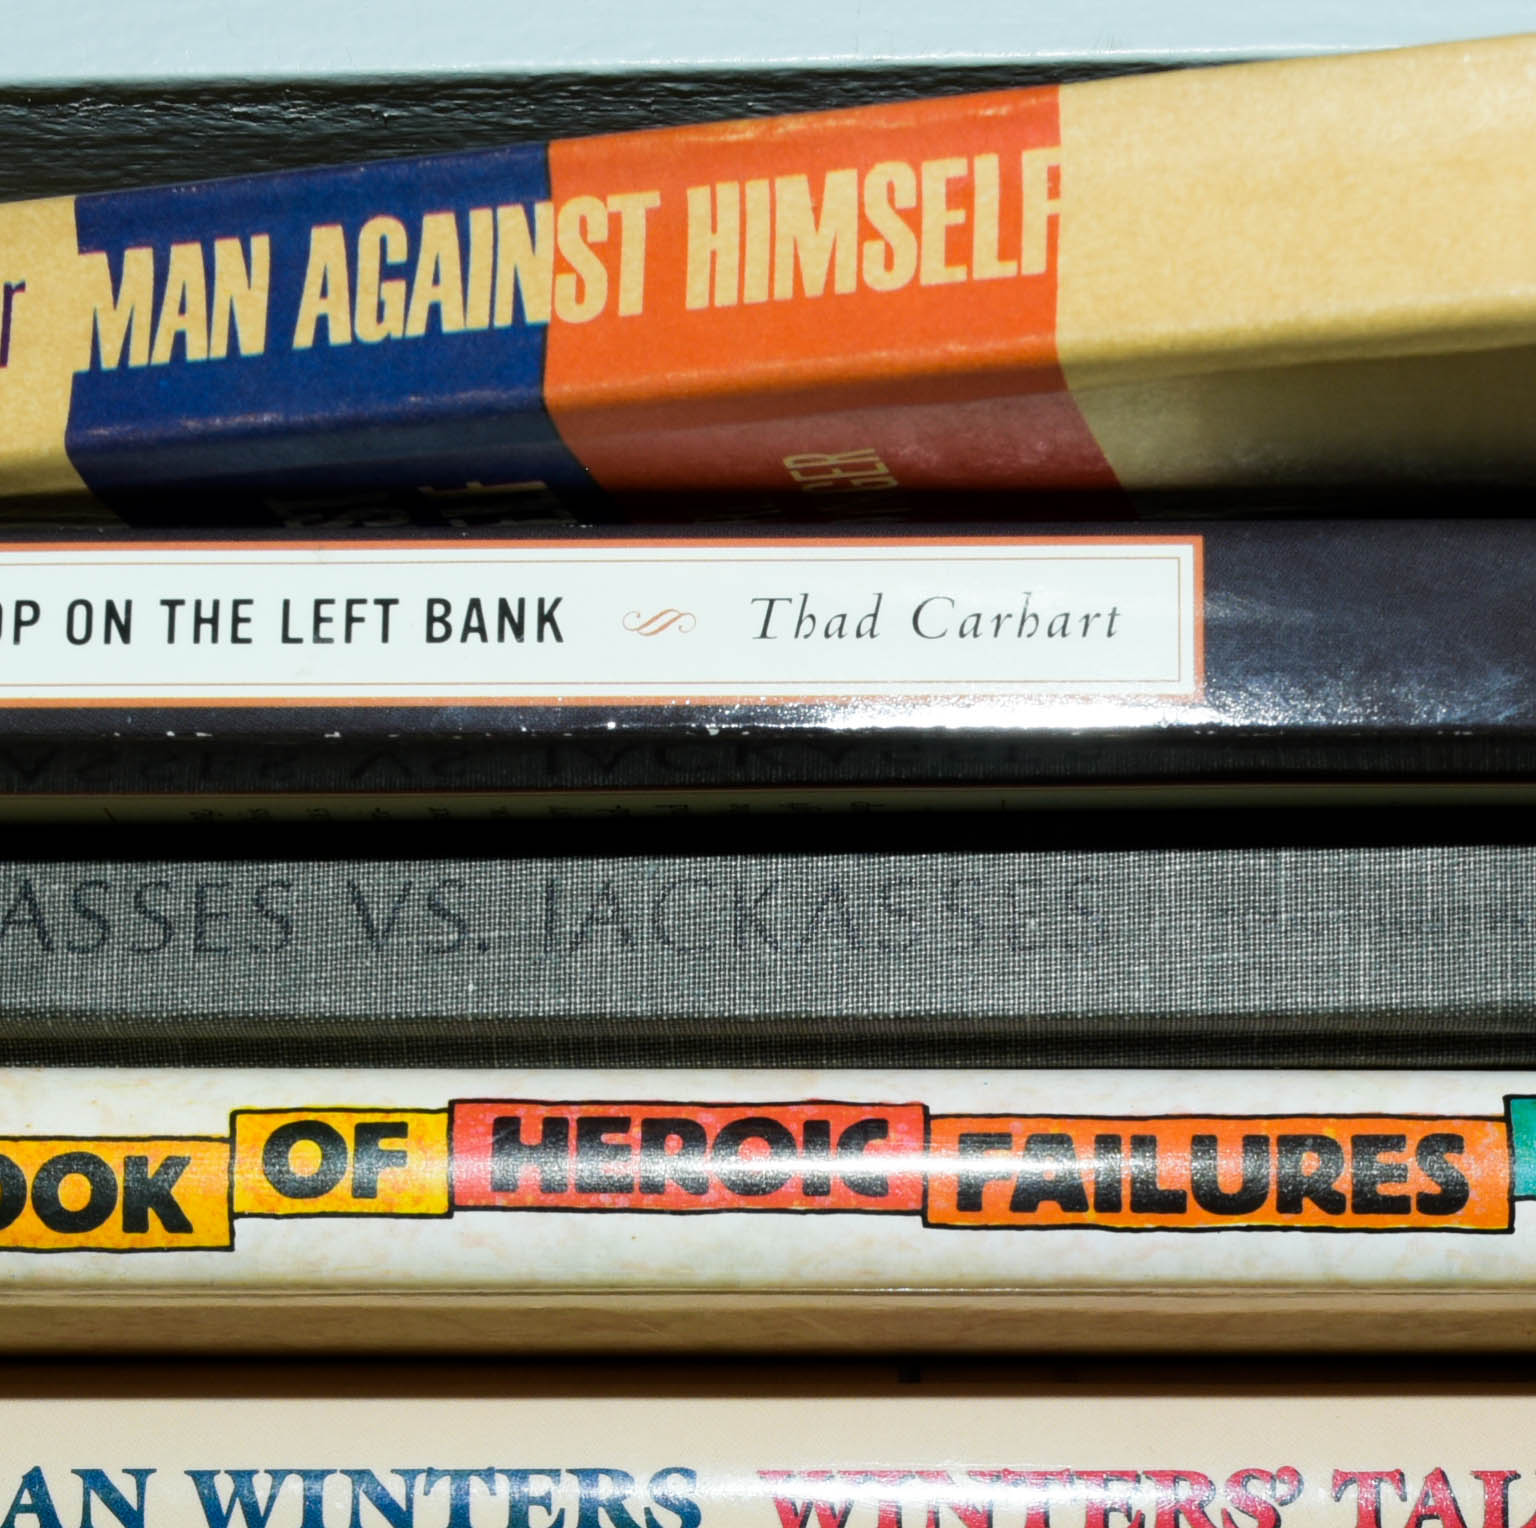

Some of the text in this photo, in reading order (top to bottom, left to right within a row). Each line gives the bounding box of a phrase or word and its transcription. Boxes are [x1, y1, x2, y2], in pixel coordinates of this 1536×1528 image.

[72, 145, 1063, 373] MAN AGAINST HIMSELF
[66, 598, 133, 645] ON
[163, 599, 254, 645] THE
[281, 598, 399, 644] LEFT
[426, 597, 565, 643] BANK
[750, 591, 1123, 640] Thad Carhart
[347, 878, 489, 955] VS.
[540, 876, 1107, 957] JACKASSES
[263, 1119, 408, 1200] OF
[490, 1115, 890, 1197] HEROIC
[956, 1132, 1470, 1216] FAILURES
